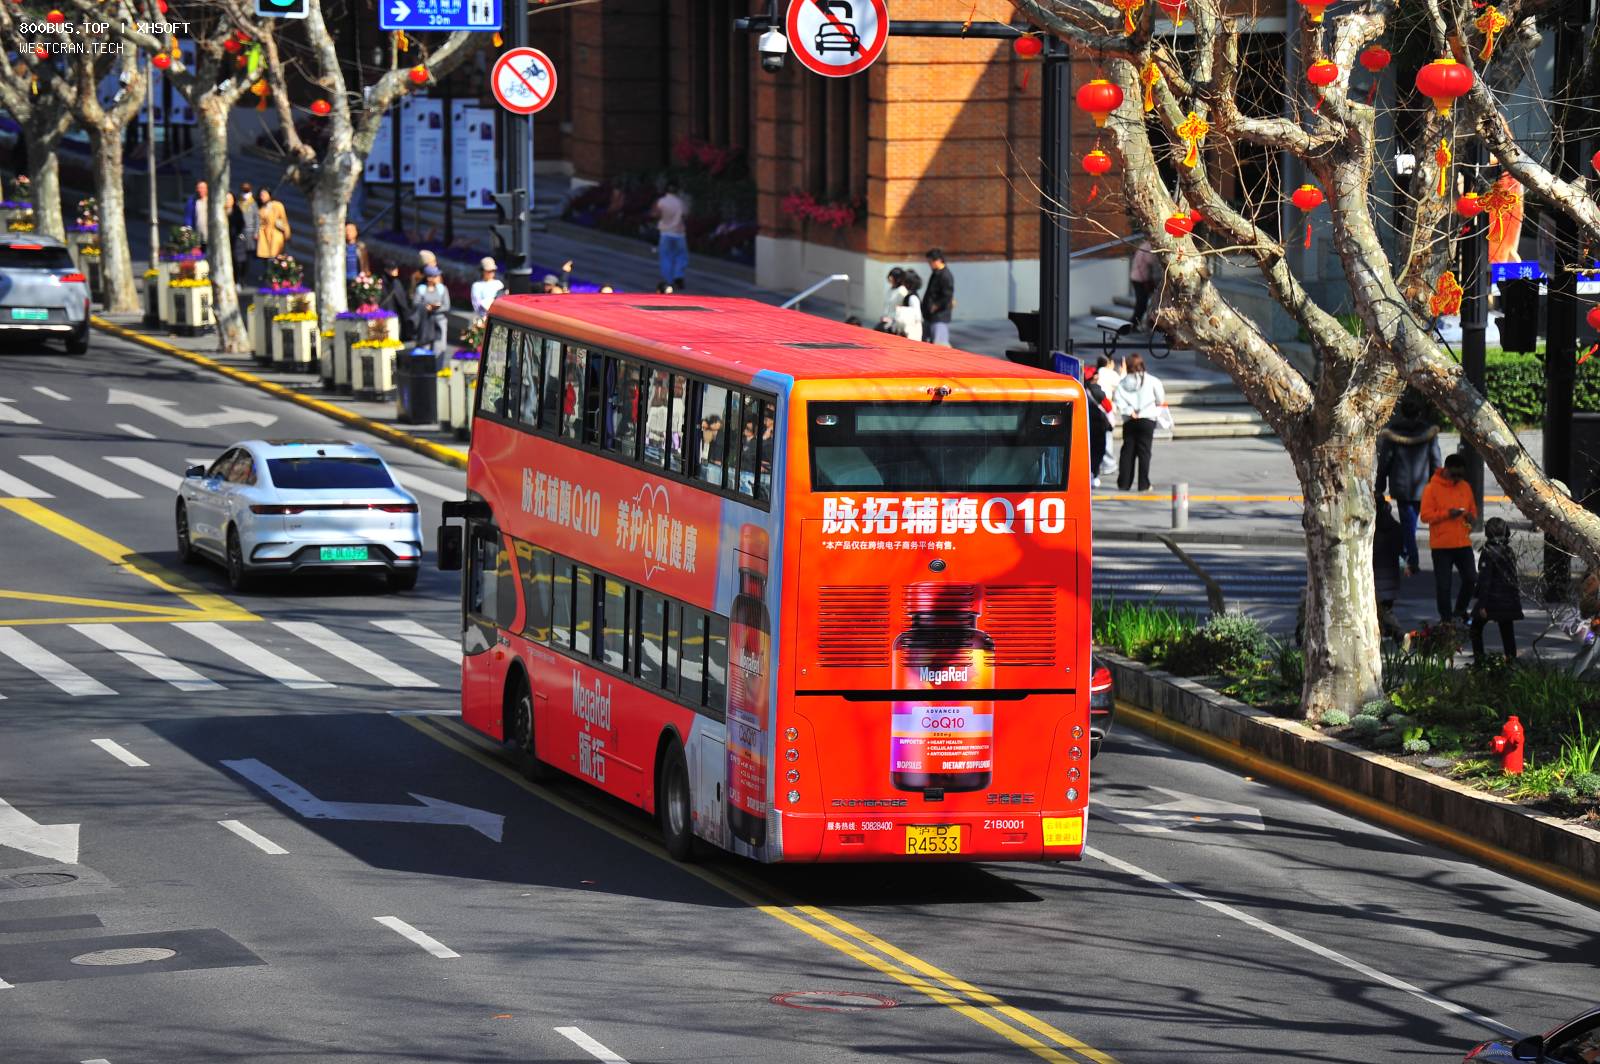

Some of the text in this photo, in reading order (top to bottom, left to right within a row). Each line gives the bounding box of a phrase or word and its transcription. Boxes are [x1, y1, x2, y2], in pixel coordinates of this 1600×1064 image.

[522, 467, 601, 537] 脉拓辅酶Q10
[822, 497, 1066, 534] 脉拓辅酶Q10
[616, 500, 698, 574] 养护心脏健康
[920, 666, 968, 685] MegaRed
[572, 668, 612, 732] MegaRed
[921, 716, 965, 729] CoQ10
[942, 761, 966, 770] DIETARY
[861, 821, 893, 831] 50828400
[983, 819, 1025, 830] Z1B0001
[908, 836, 958, 852] R4533
